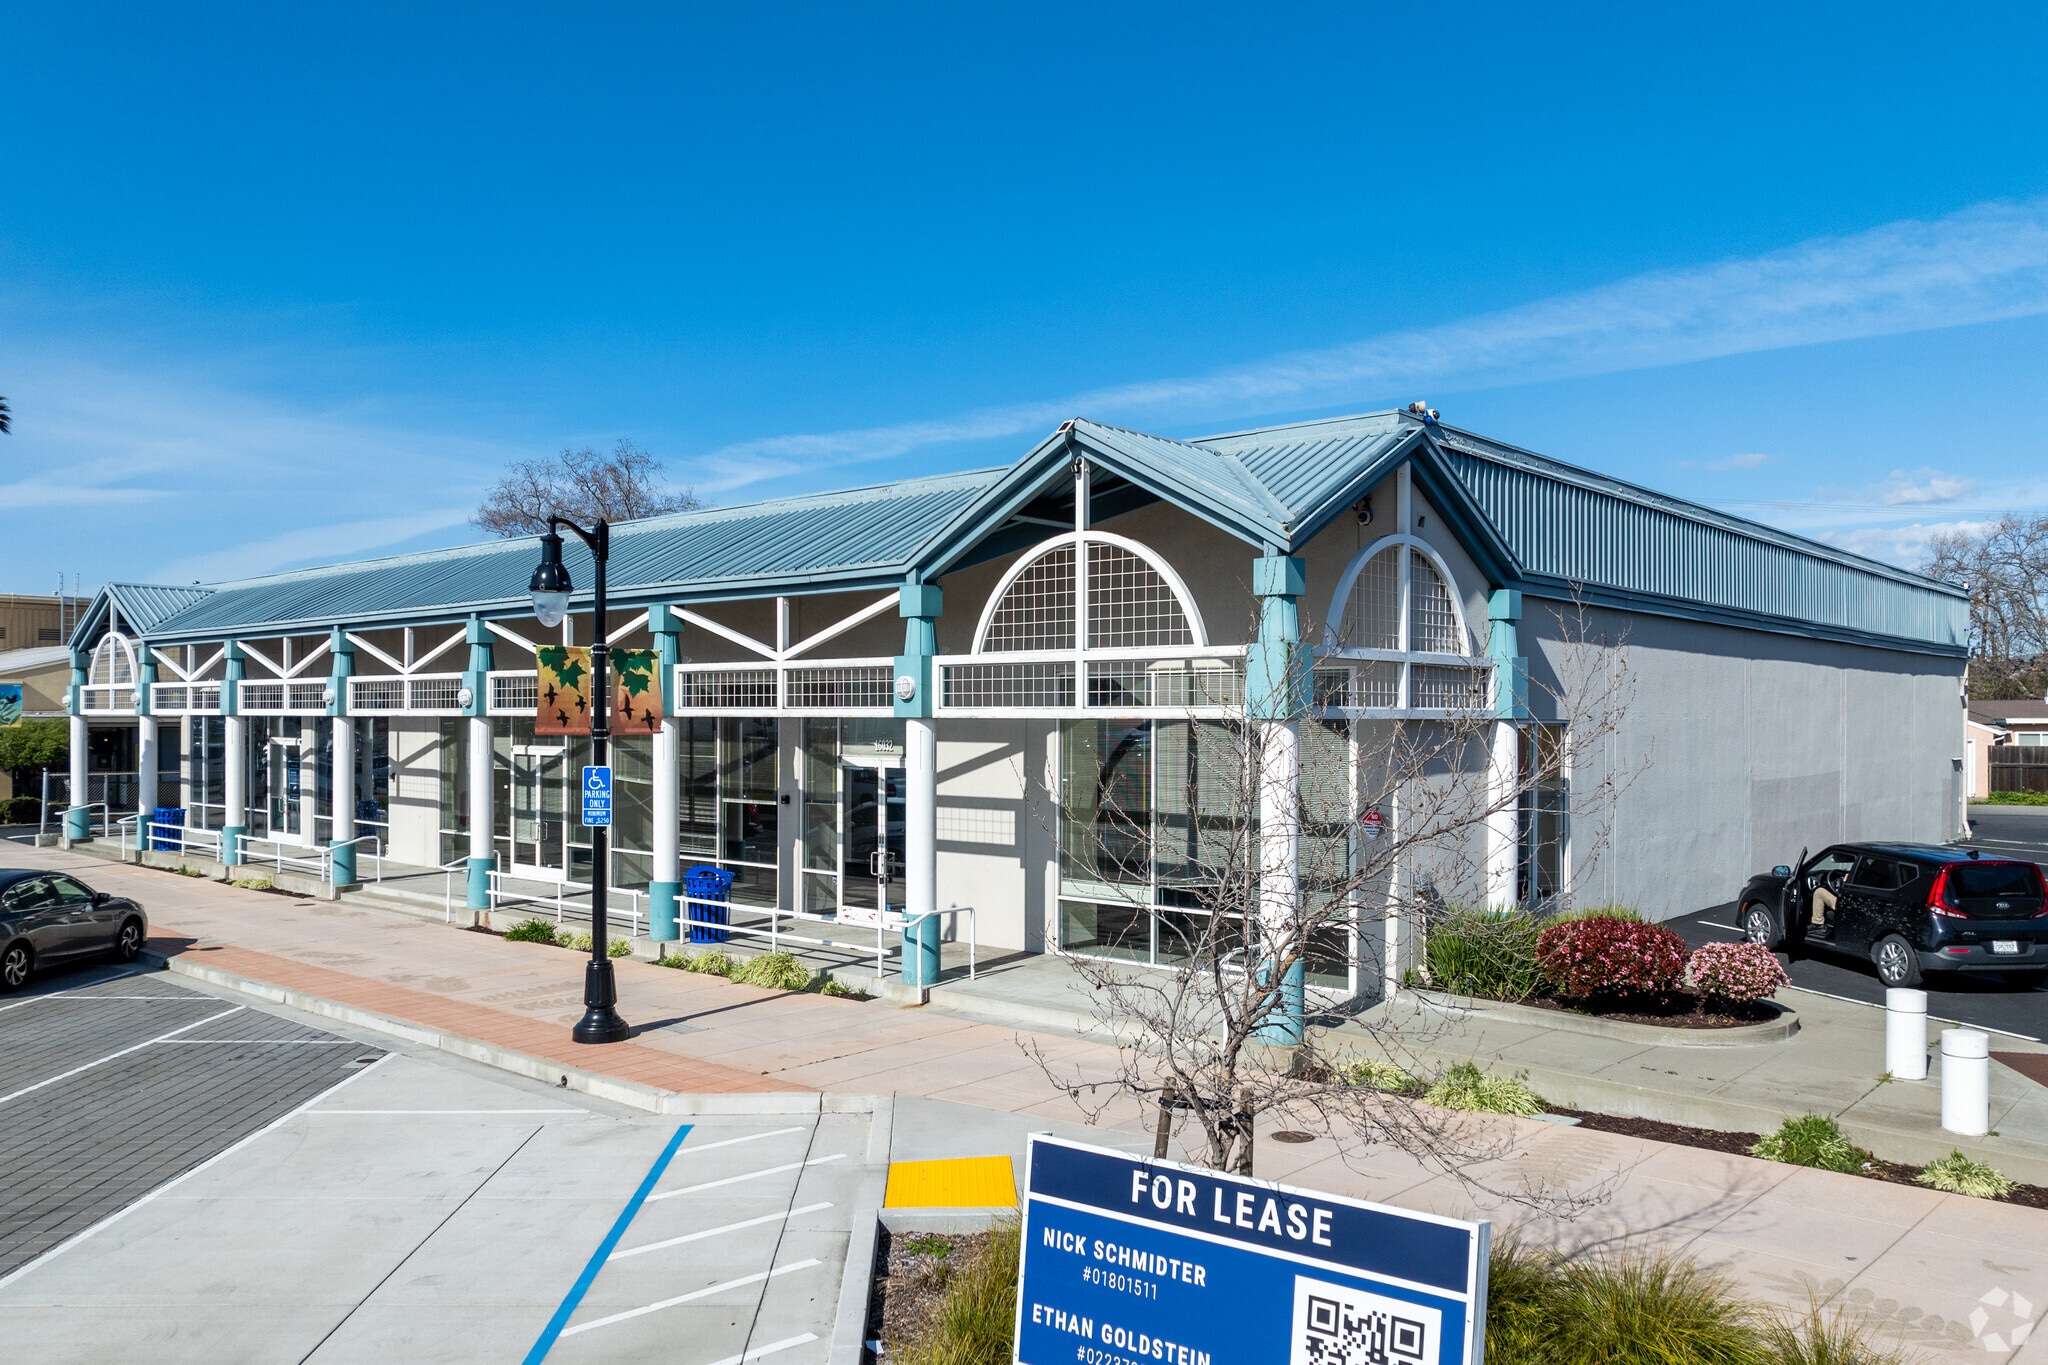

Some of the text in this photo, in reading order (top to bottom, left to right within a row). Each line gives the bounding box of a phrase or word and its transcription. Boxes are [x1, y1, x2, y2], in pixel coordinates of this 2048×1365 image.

[584, 790, 610, 798] PARKING
[590, 799, 605, 808] ONLY
[1131, 1169, 1333, 1247] FOR LEASE
[1043, 1227, 1207, 1287] NICK SCHMIDTER
[1082, 1265, 1158, 1301] #01801511
[1032, 1303, 1211, 1365] ETHAN GOLDSTEIN
